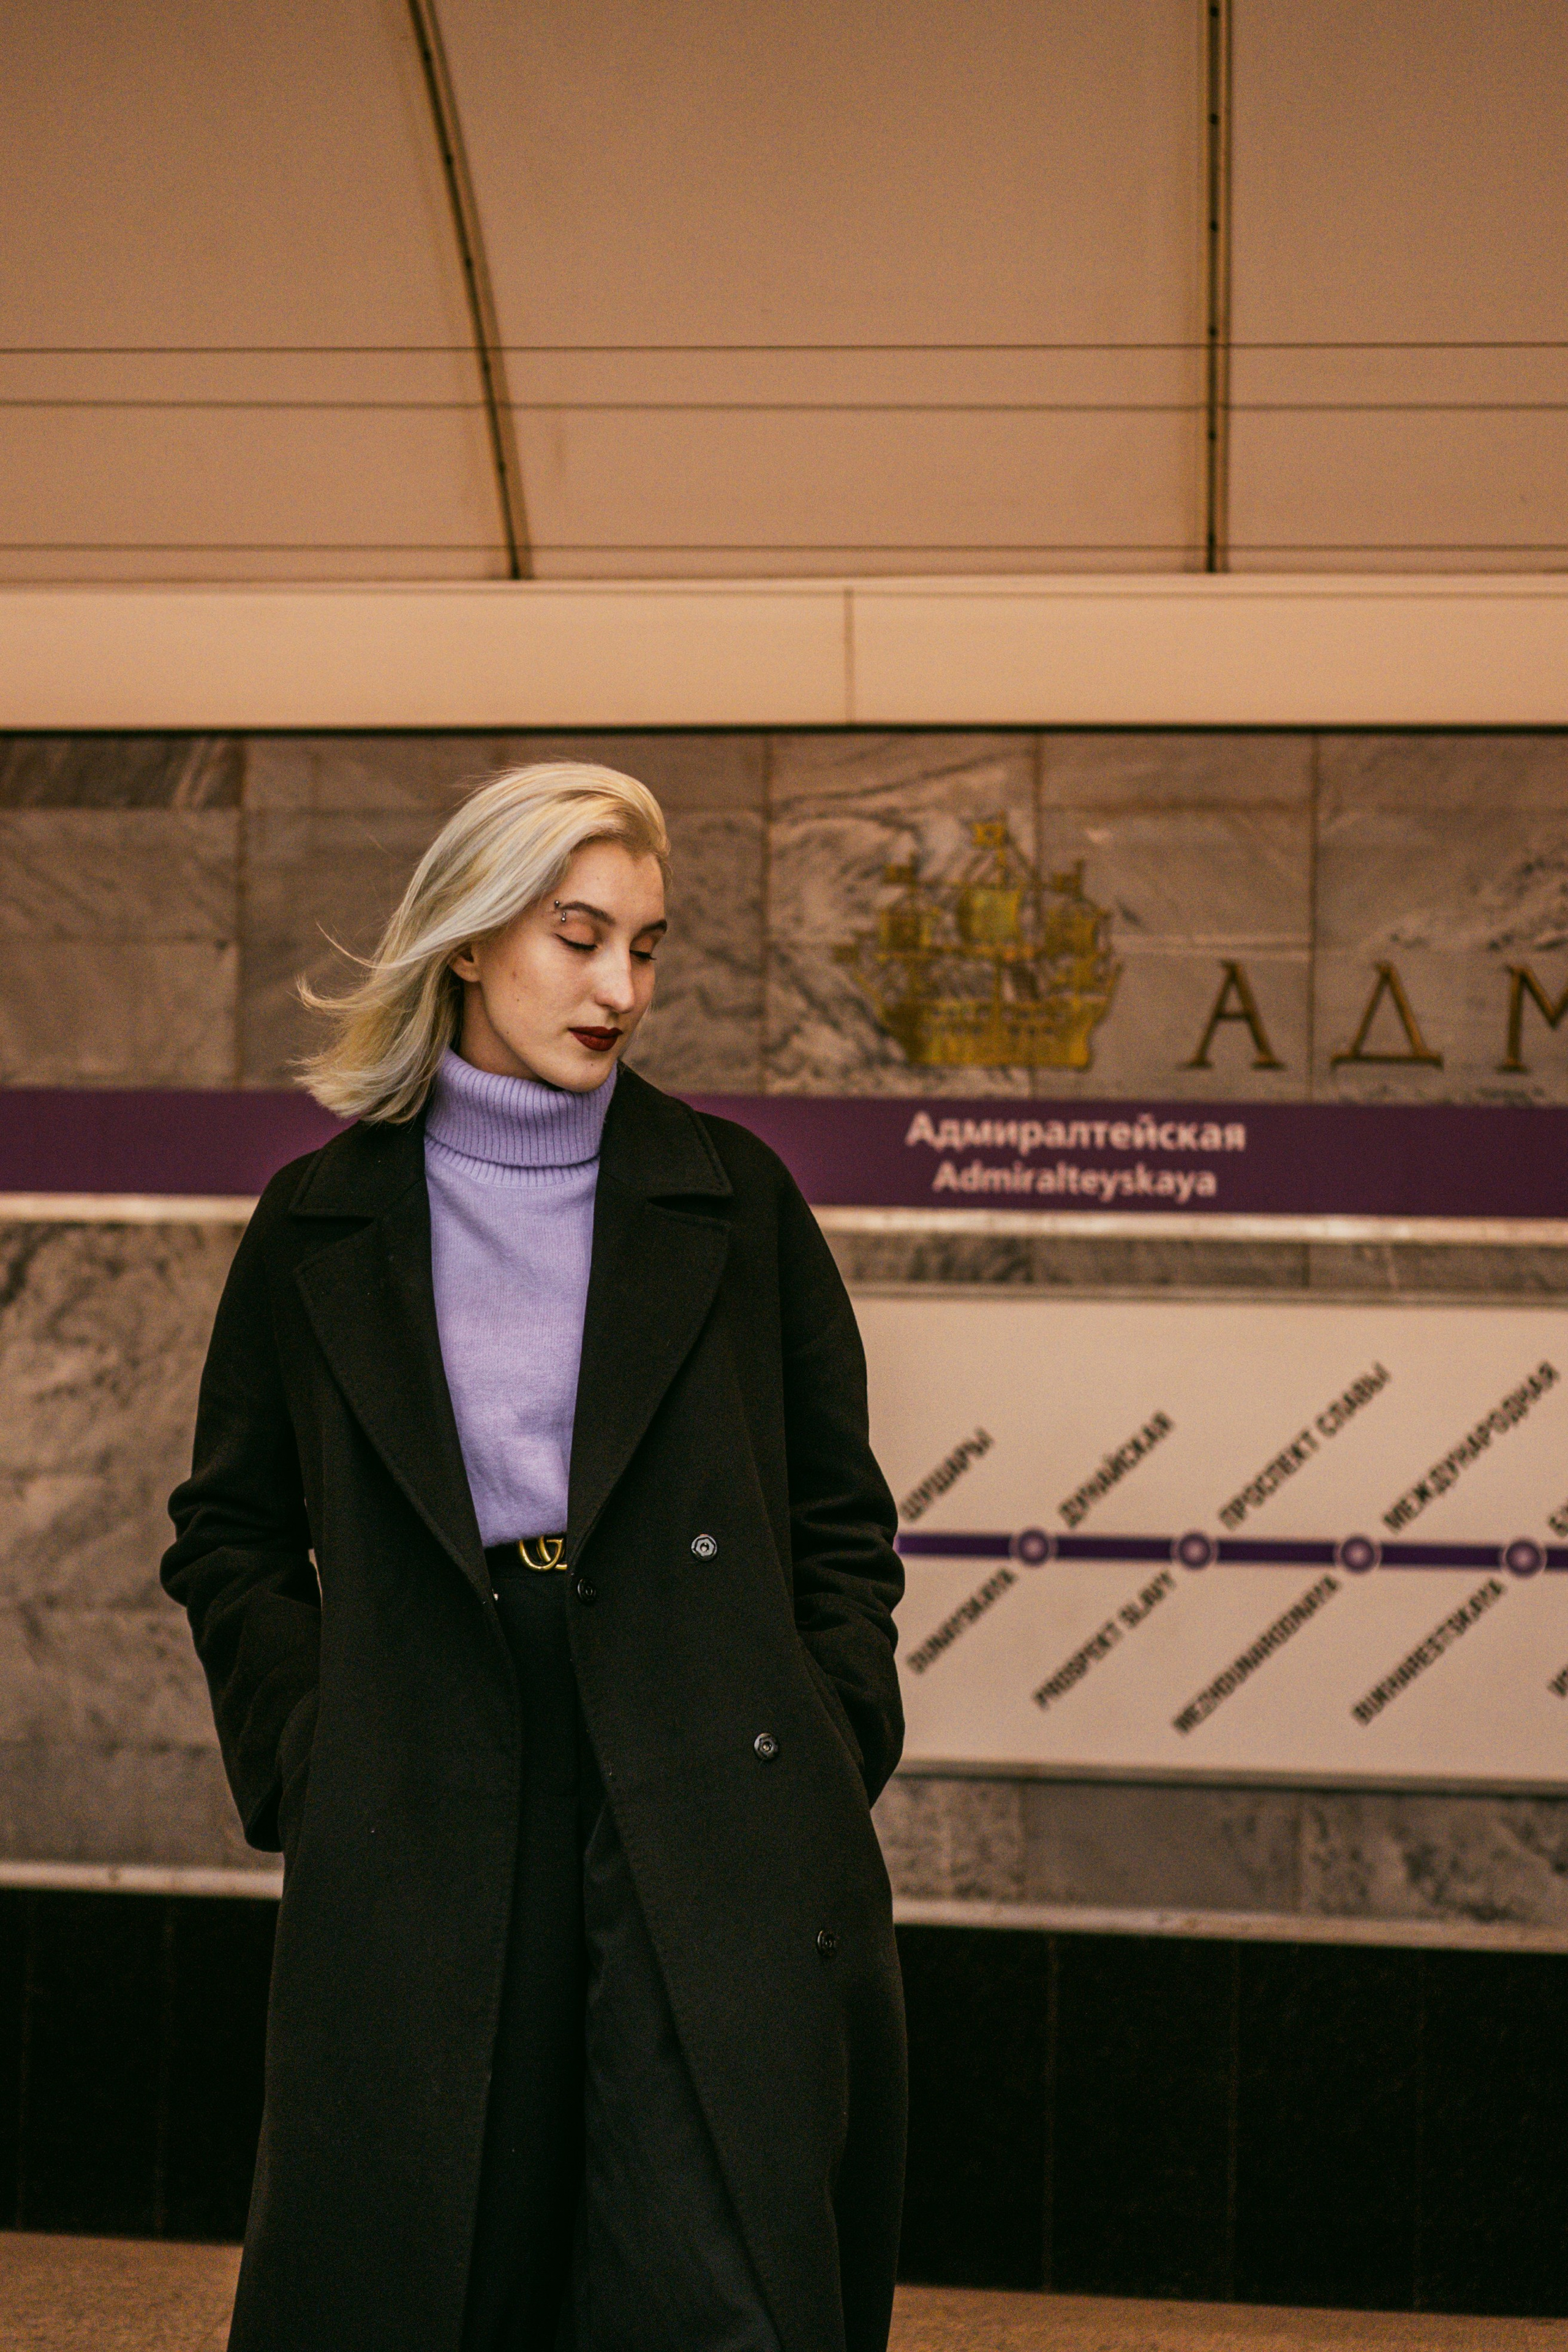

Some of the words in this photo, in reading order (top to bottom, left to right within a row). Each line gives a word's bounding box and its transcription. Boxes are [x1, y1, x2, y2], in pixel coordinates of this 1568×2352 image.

[905, 1110, 1246, 1156] Адмиралтейская
[932, 1160, 1218, 1203] Admiralteyskaya
[900, 1427, 993, 1523] ШУШАРЫ
[1058, 1411, 1174, 1529] ДУНАЙСКАЯ
[1218, 1430, 1317, 1530] ПРОСПЕКТ
[1315, 1363, 1390, 1437] СЛАВЫ
[1382, 1361, 1559, 1533] МЕЖДУНАРОДНАЯ
[1033, 1621, 1121, 1709] PROSPEKT
[1118, 1571, 1176, 1628] SLAVY
